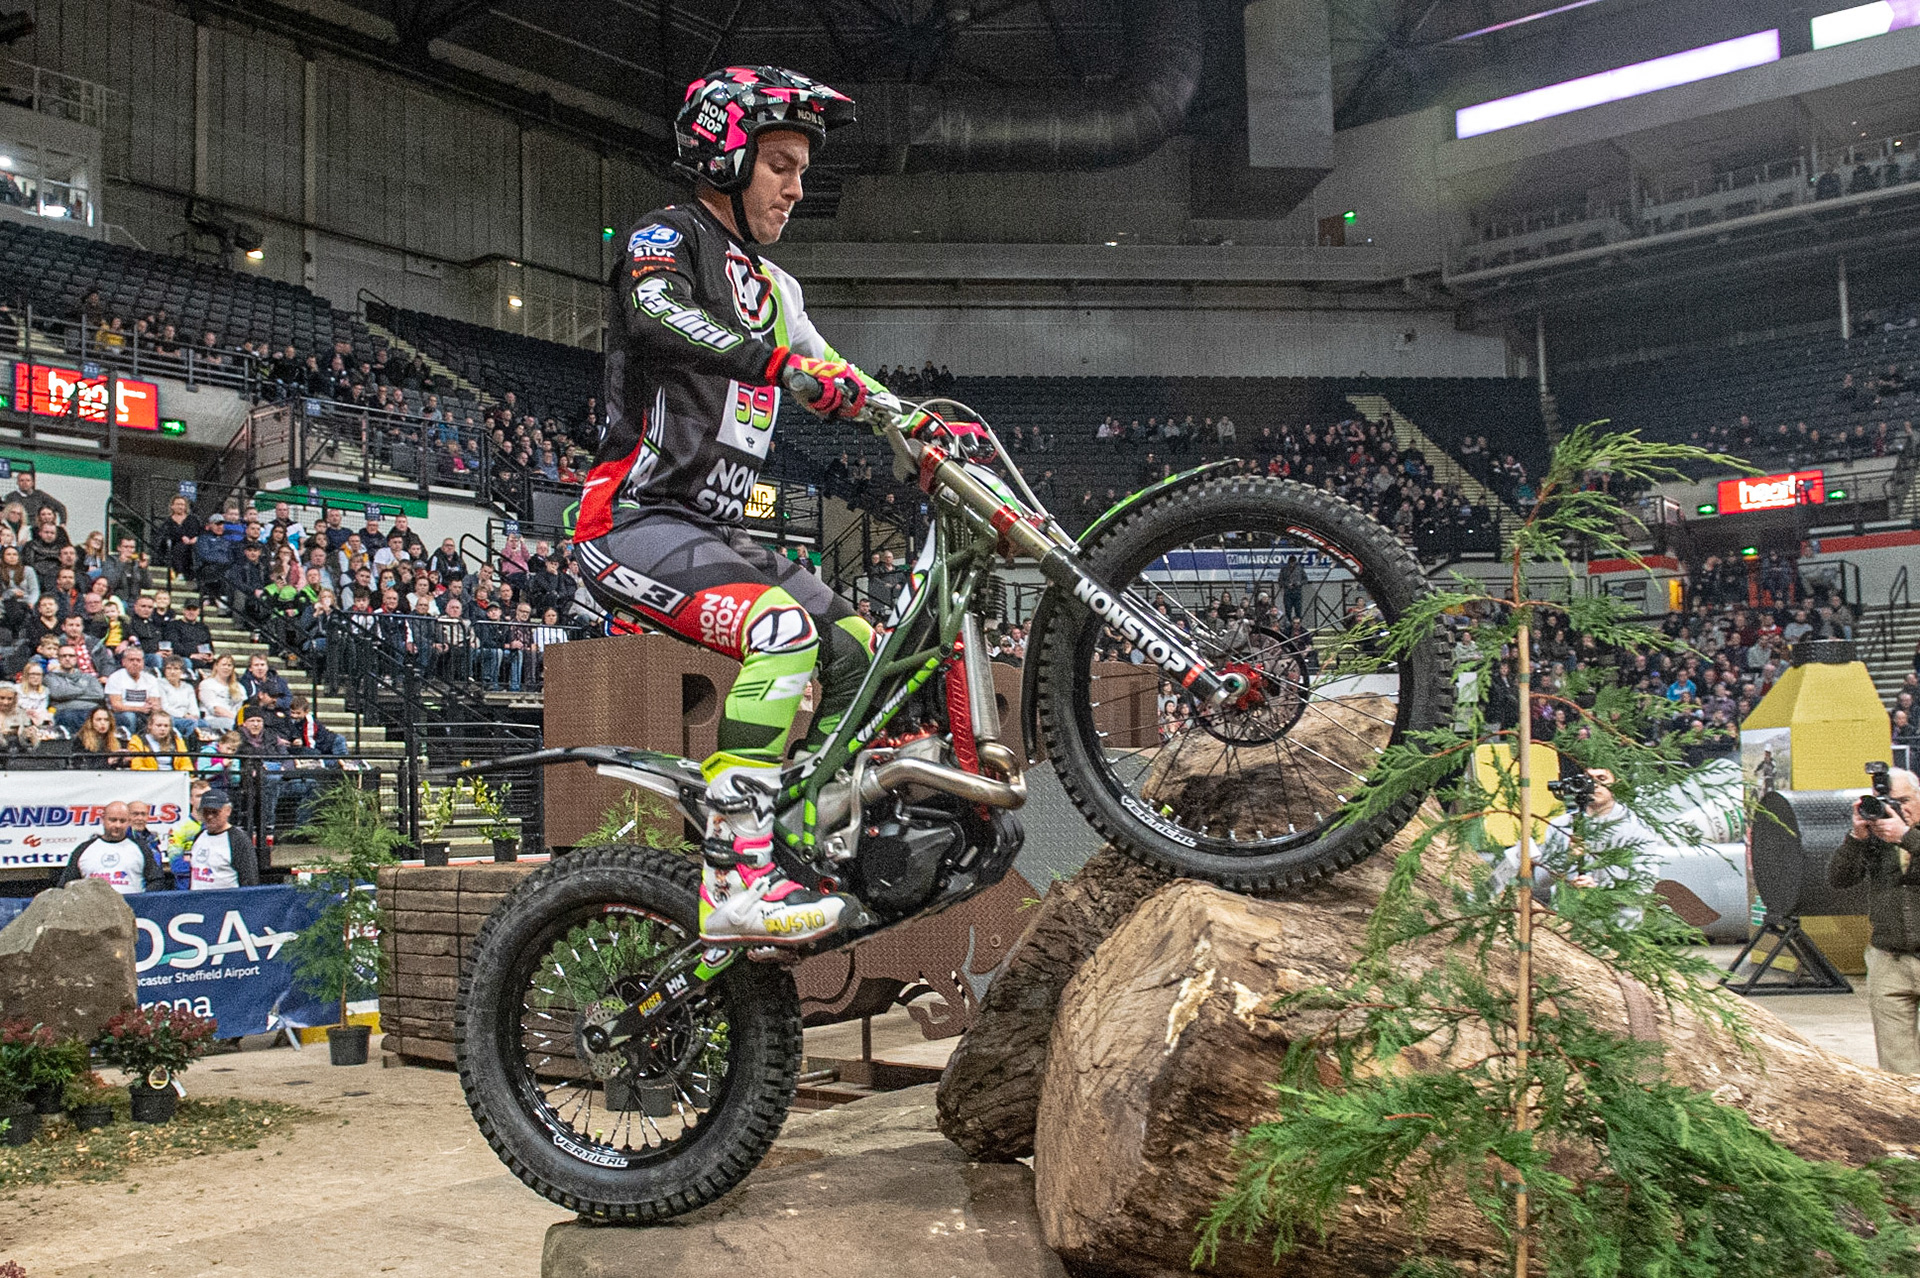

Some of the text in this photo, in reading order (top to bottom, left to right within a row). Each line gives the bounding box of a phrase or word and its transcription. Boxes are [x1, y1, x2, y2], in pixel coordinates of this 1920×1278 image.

[696, 112, 723, 134] STOP
[701, 99, 729, 125] NON
[735, 381, 775, 432] 59
[706, 458, 760, 500] NON
[700, 593, 721, 644] NON
[715, 596, 738, 647] STOP
[1073, 577, 1187, 673] NONSTOP
[175, 969, 222, 984] Sheffield
[224, 965, 260, 980] Airport
[553, 1133, 628, 1168] VERTICAL
